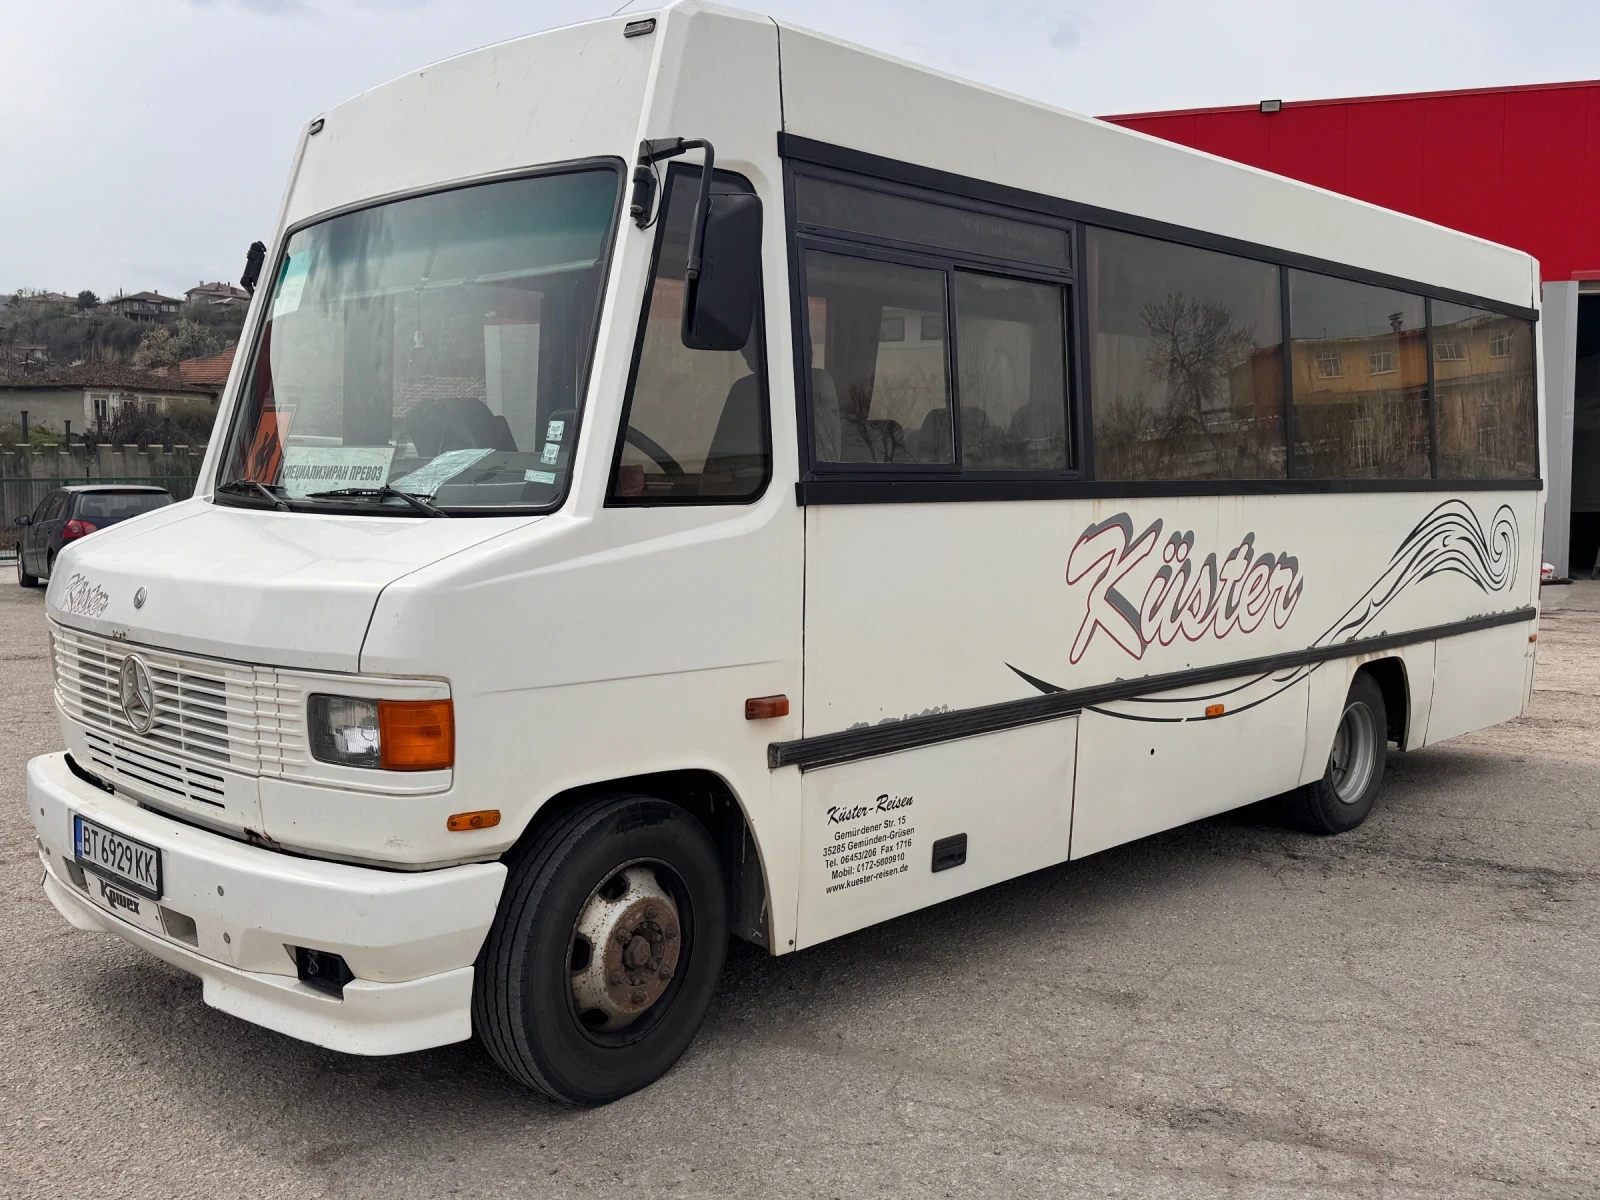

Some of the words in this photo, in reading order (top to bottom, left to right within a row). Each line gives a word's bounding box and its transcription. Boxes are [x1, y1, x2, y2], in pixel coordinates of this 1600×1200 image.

[283, 465, 350, 481] СПЕЦИАЛИЗИРАН
[350, 466, 383, 481] ПРЕВОЗ
[60, 572, 109, 617] Küster
[1066, 512, 1304, 664] Küster
[827, 794, 914, 825] Küster-Reisen
[883, 819, 896, 829] Str.
[897, 815, 906, 825] 15
[83, 825, 99, 860] BT
[101, 834, 133, 875] 6929
[135, 848, 154, 885] KK
[823, 843, 846, 857] 35285
[847, 827, 915, 851] Gemünden-Grüsen
[825, 858, 839, 868] Tel.
[880, 844, 894, 854] Fax
[896, 838, 912, 851] 1716
[825, 864, 909, 894] www.kuester-reisen.de
[831, 866, 855, 880] Mobil:
